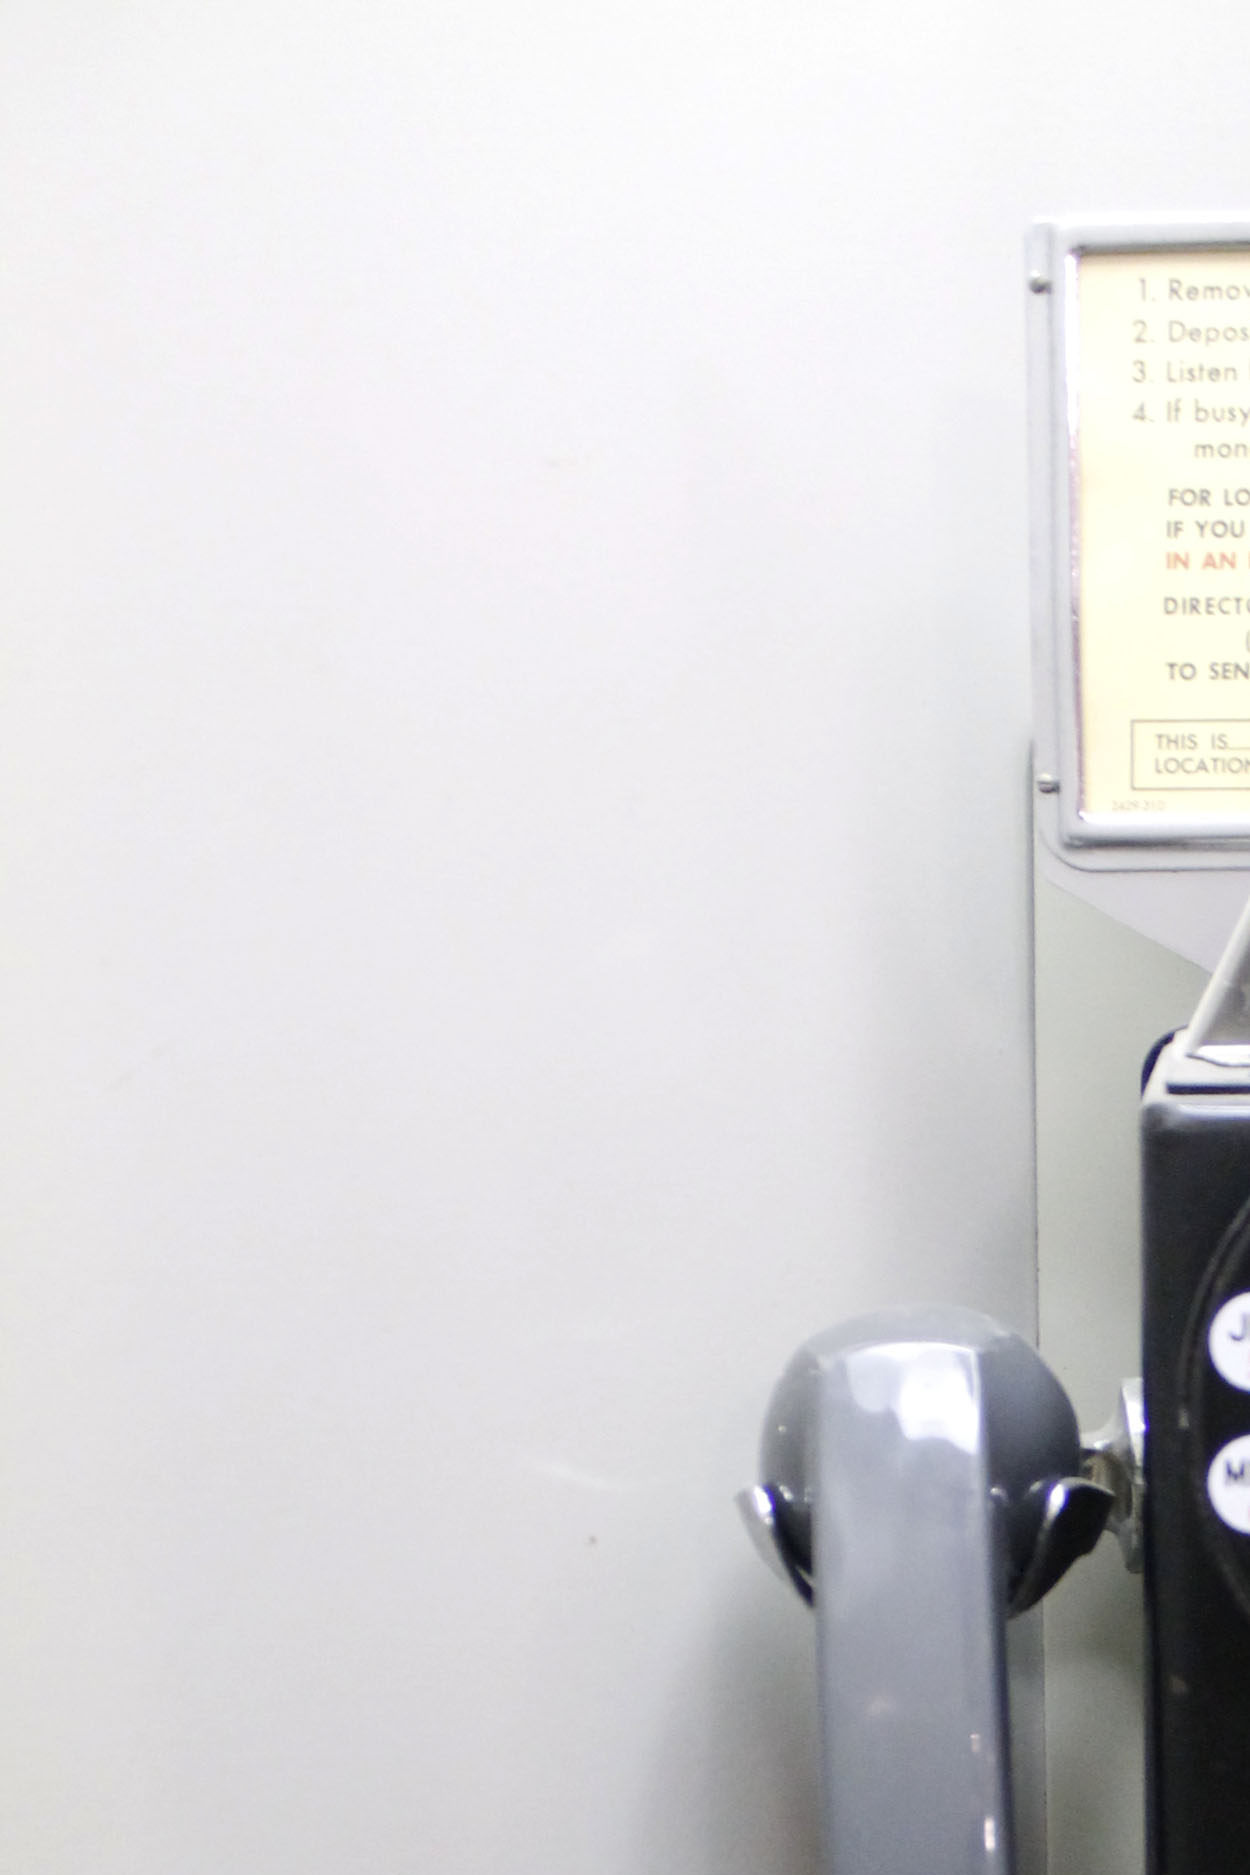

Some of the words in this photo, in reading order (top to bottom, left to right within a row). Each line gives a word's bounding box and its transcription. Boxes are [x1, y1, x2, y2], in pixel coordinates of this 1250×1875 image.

[1138, 277, 1157, 301] 1.
[1132, 319, 1156, 343] 2.
[1131, 359, 1154, 383] 3.
[1166, 360, 1238, 383] Listen
[1131, 401, 1155, 422] 4.
[1166, 398, 1182, 422] If
[1194, 398, 1250, 428] busy
[1168, 487, 1212, 506] FOR
[1165, 519, 1184, 539] IF
[1194, 519, 1246, 539] YOU
[1164, 551, 1191, 570] IN
[1202, 551, 1238, 570] AN
[1166, 662, 1198, 682] TO
[1155, 733, 1199, 750] THIS
[1209, 733, 1229, 751] IS
